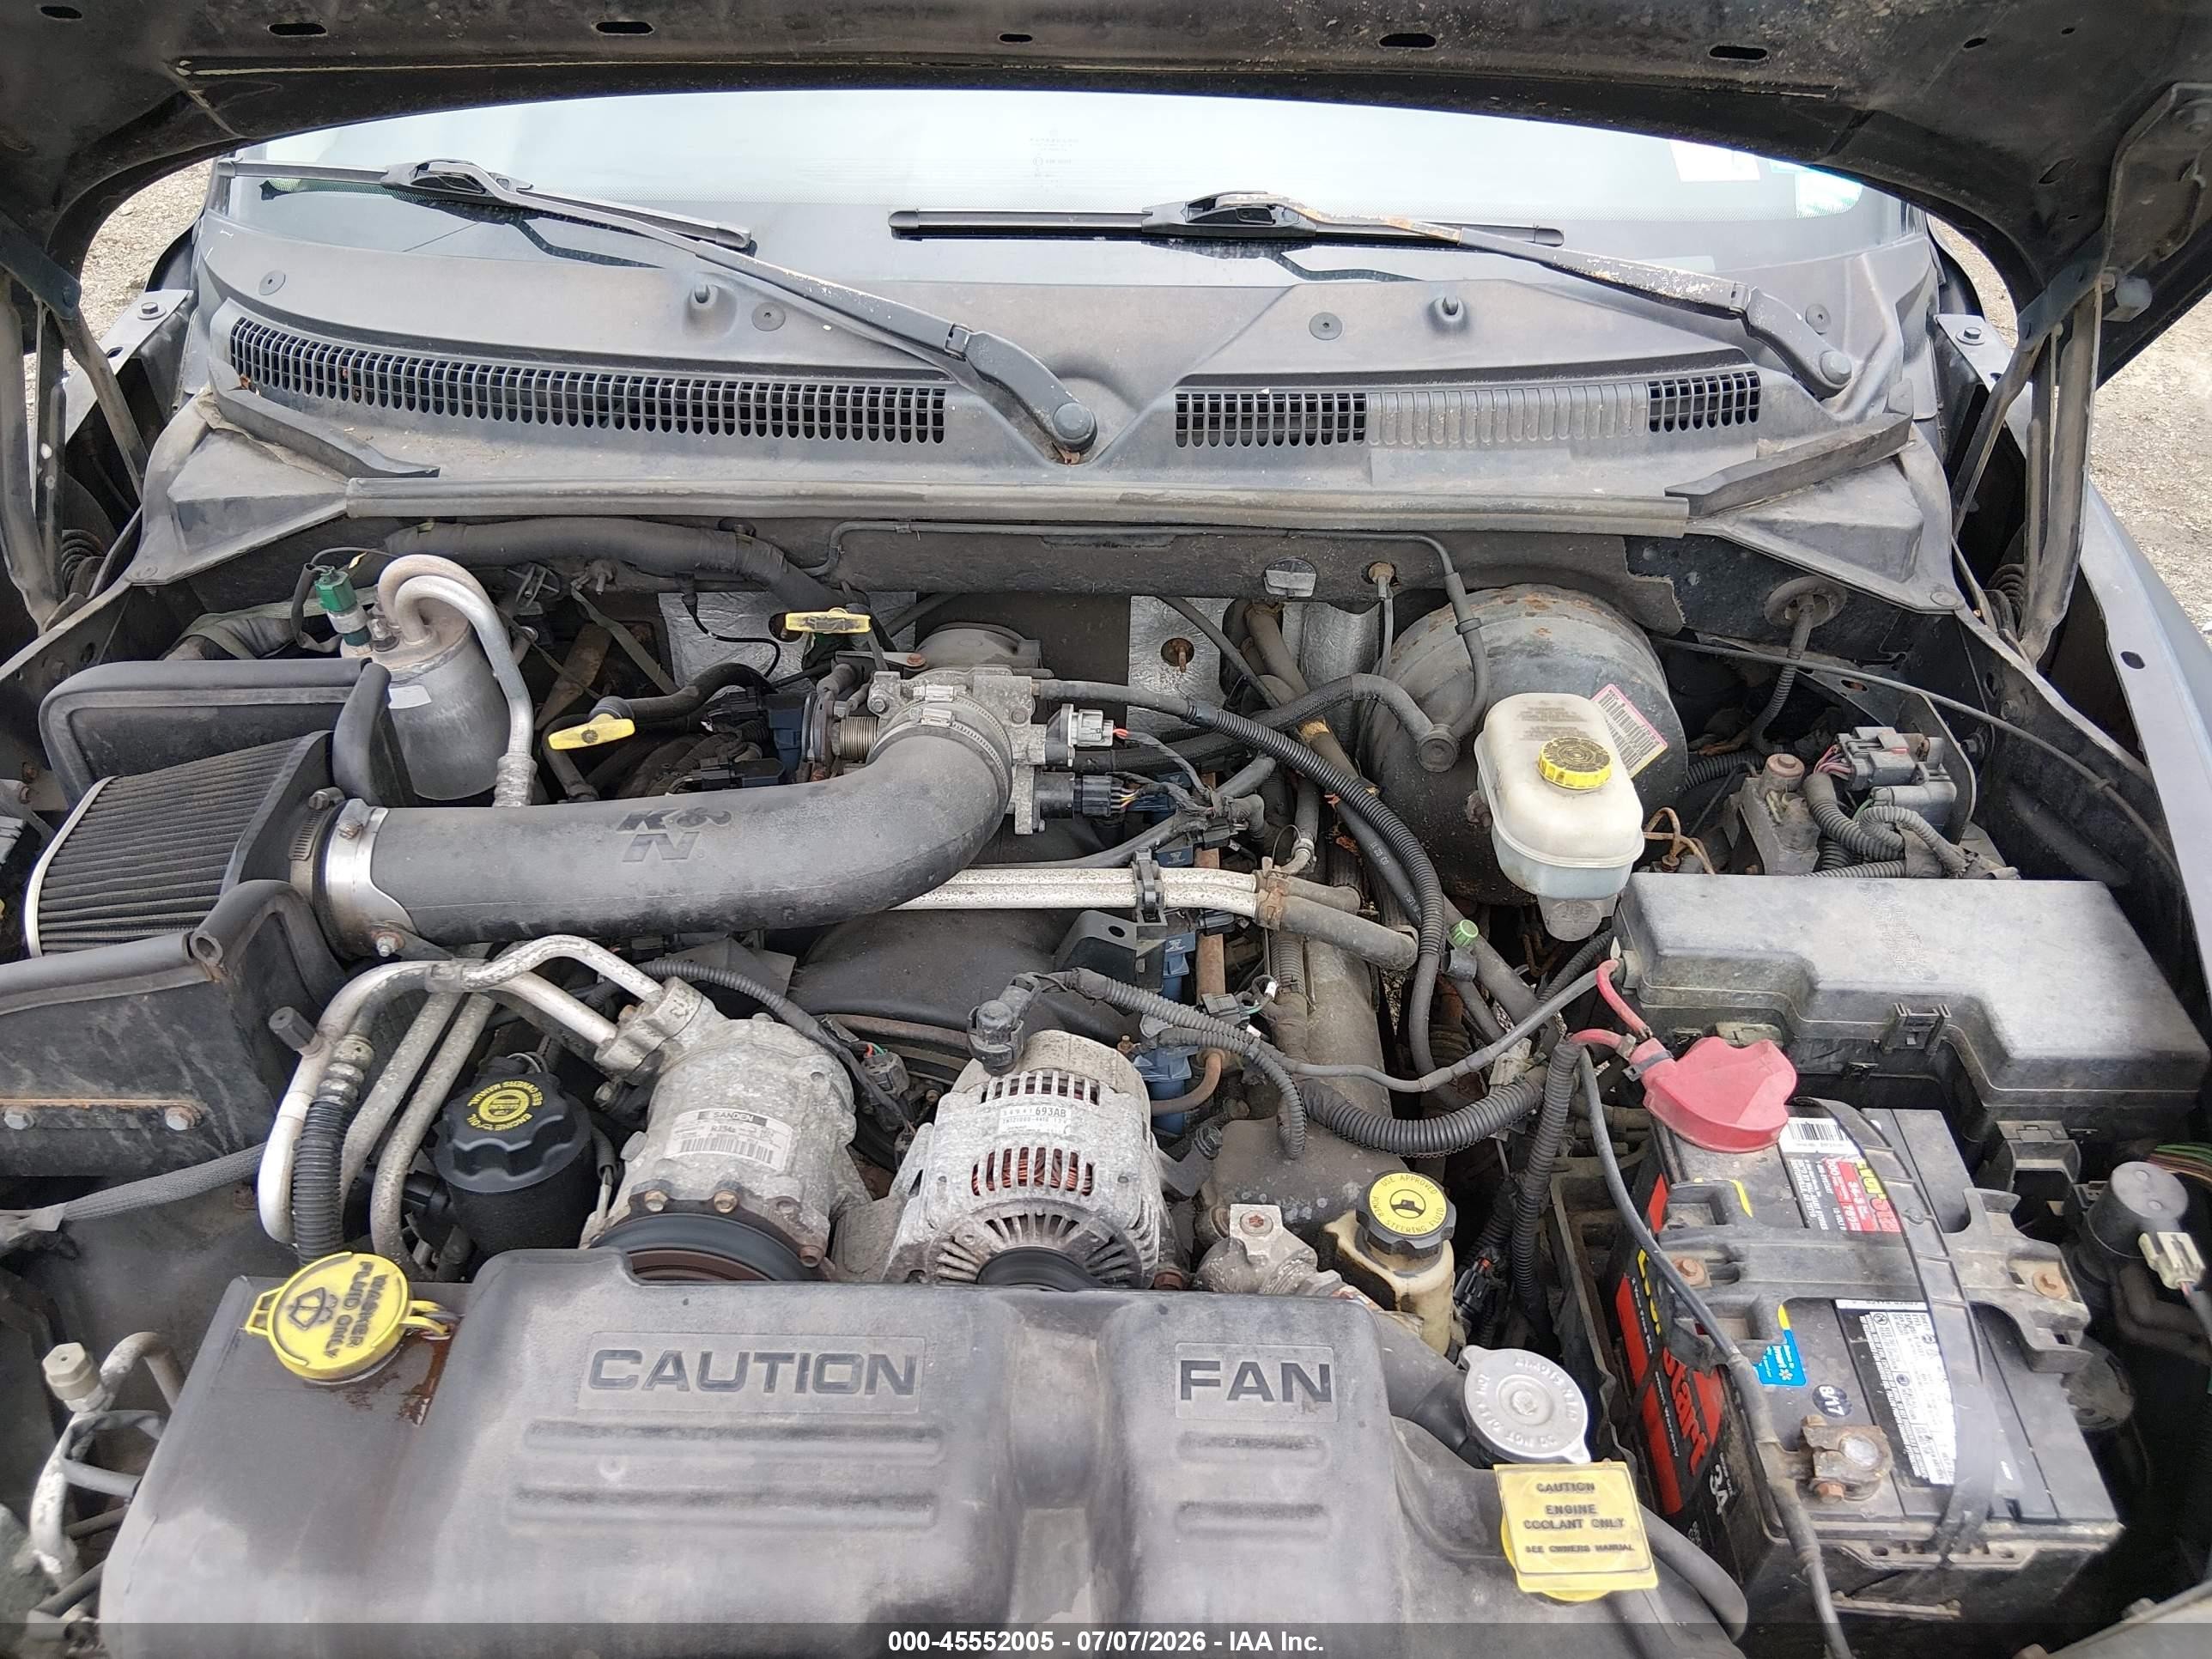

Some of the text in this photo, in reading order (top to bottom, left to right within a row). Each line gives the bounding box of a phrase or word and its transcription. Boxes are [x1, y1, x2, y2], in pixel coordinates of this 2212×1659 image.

[1380, 856, 1389, 866] 03
[1404, 892, 1417, 906] USA
[467, 1080, 543, 1107] SEE OWNERS MANUAL
[714, 1112, 754, 1121] SANDEN
[1036, 1107, 1066, 1117] 693AB
[467, 1113, 533, 1131] ENGINE OIL
[1381, 1175, 1437, 1194] USE APPROVED
[1372, 1196, 1444, 1233] POWER STEERING FLUID
[324, 1261, 374, 1359] FLUID ONLY
[347, 1274, 388, 1349] WASHER
[586, 1348, 1333, 1403] CAUTION FAN
[1819, 1384, 1844, 1415] 8/17
[1536, 1481, 1595, 1493] CAUTION
[1708, 1463, 1729, 1515] 34
[1545, 1504, 1598, 1515] ENGINE
[1524, 1519, 1625, 1529] COOLANT ONLY
